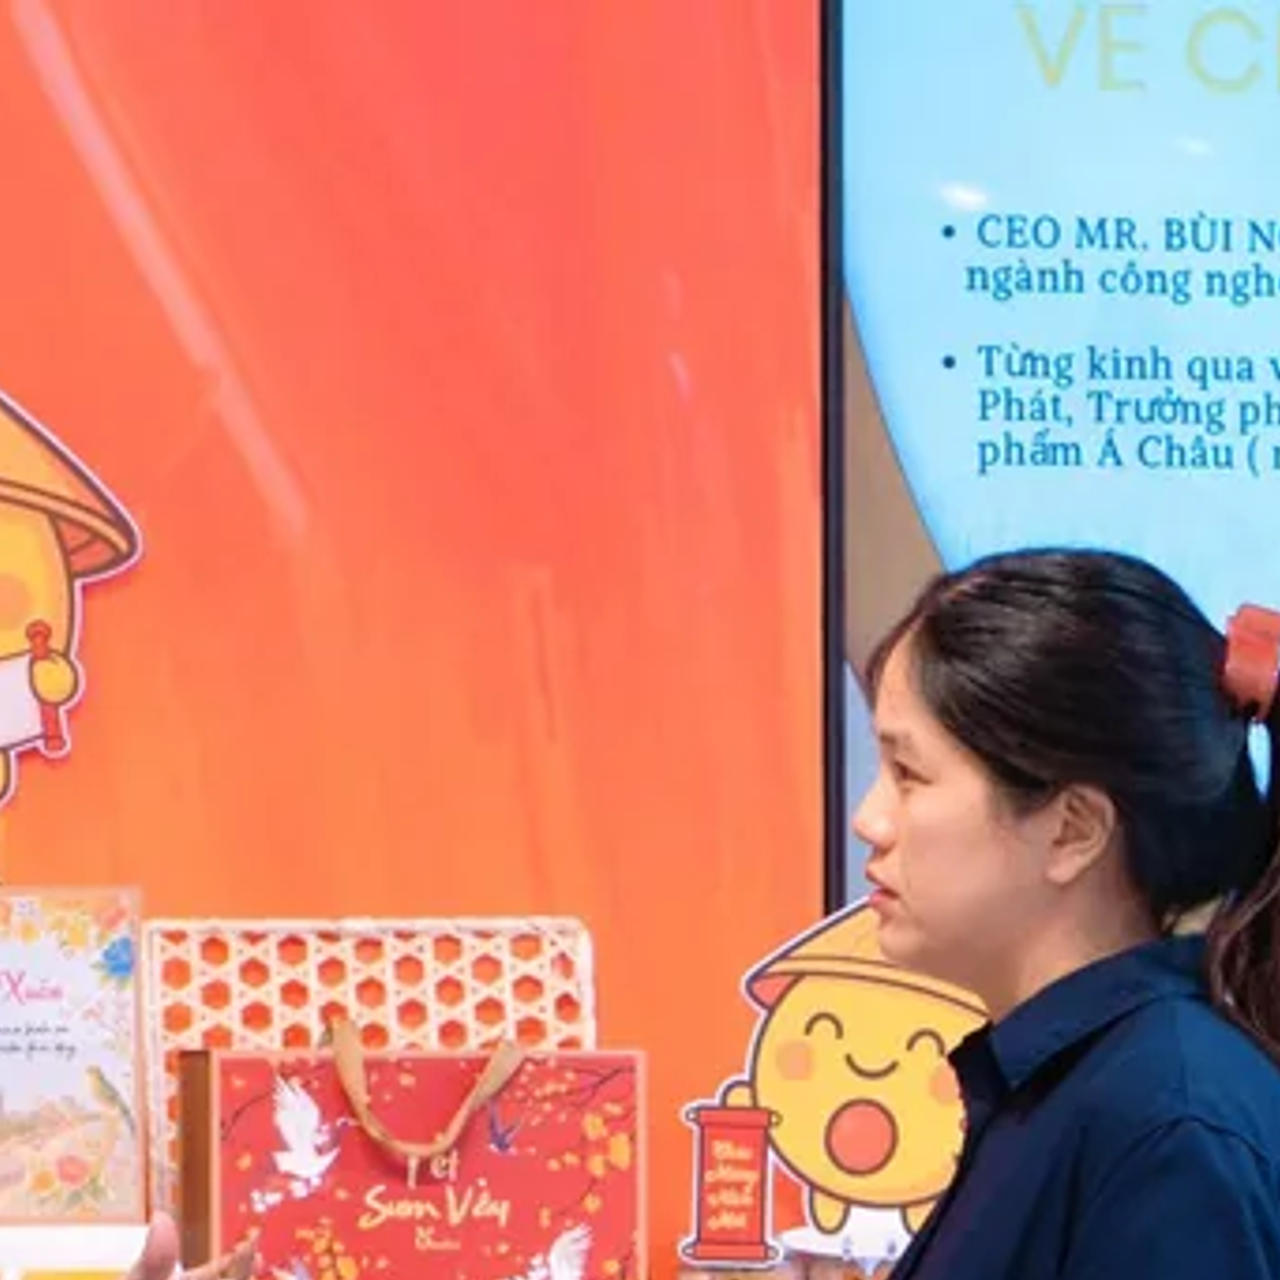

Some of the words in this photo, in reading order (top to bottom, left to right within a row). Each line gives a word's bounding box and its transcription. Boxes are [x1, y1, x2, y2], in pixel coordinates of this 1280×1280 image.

[977, 214, 1062, 249] CEO
[1075, 217, 1149, 251] MR.
[1165, 211, 1233, 252] BÙI
[966, 258, 1084, 301] ngành
[1098, 260, 1191, 305] công
[977, 341, 1074, 389] Từng
[1086, 345, 1173, 381] kinh
[1187, 356, 1254, 391] qua
[977, 387, 1075, 428] Phát,
[1086, 388, 1226, 436] Trưởng
[1096, 427, 1125, 468] Á
[1136, 433, 1235, 470] Châu
[357, 1184, 440, 1230] Sum
